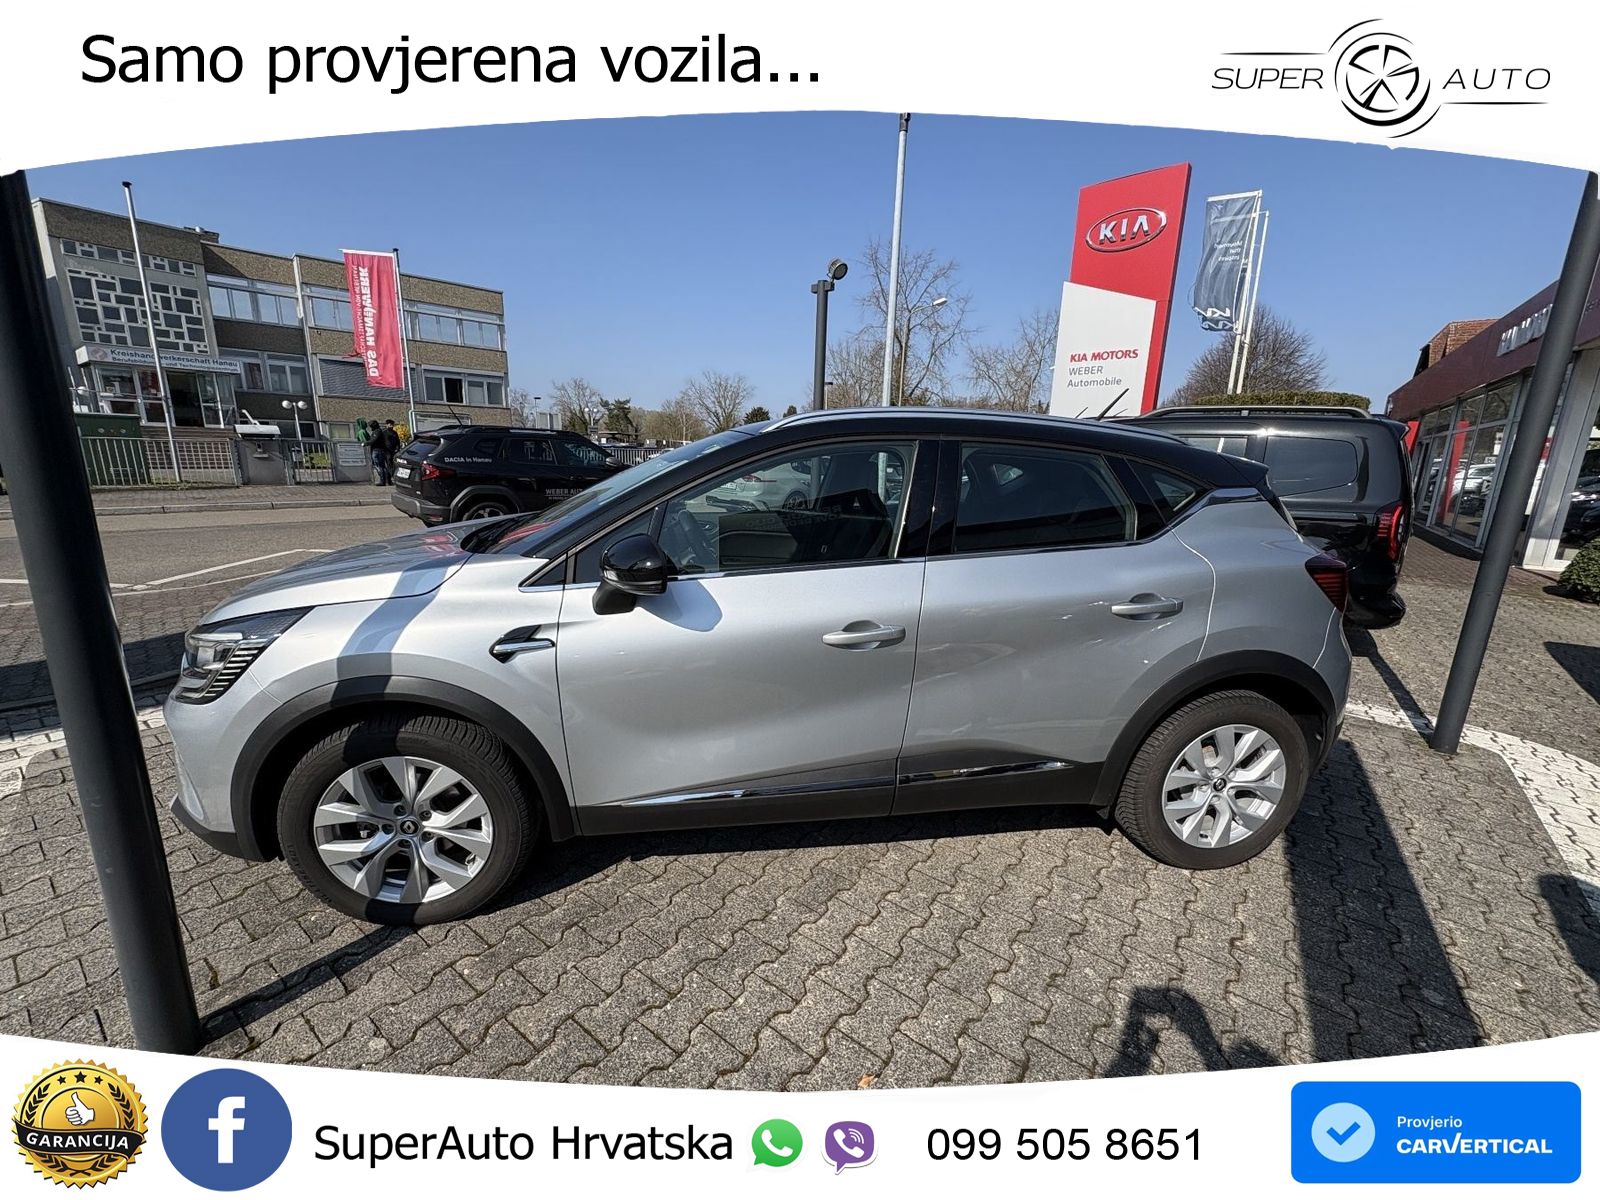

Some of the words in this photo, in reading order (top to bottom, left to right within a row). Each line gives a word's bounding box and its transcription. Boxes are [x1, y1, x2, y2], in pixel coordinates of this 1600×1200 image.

[1099, 214, 1150, 244] KIA
[1070, 352, 1088, 363] KIA
[1090, 349, 1139, 361] MOTORS
[213, 359, 238, 367] Hanau
[1068, 366, 1103, 376] WEBER
[1067, 377, 1122, 388] Automobile
[546, 488, 569, 496] WEBER
